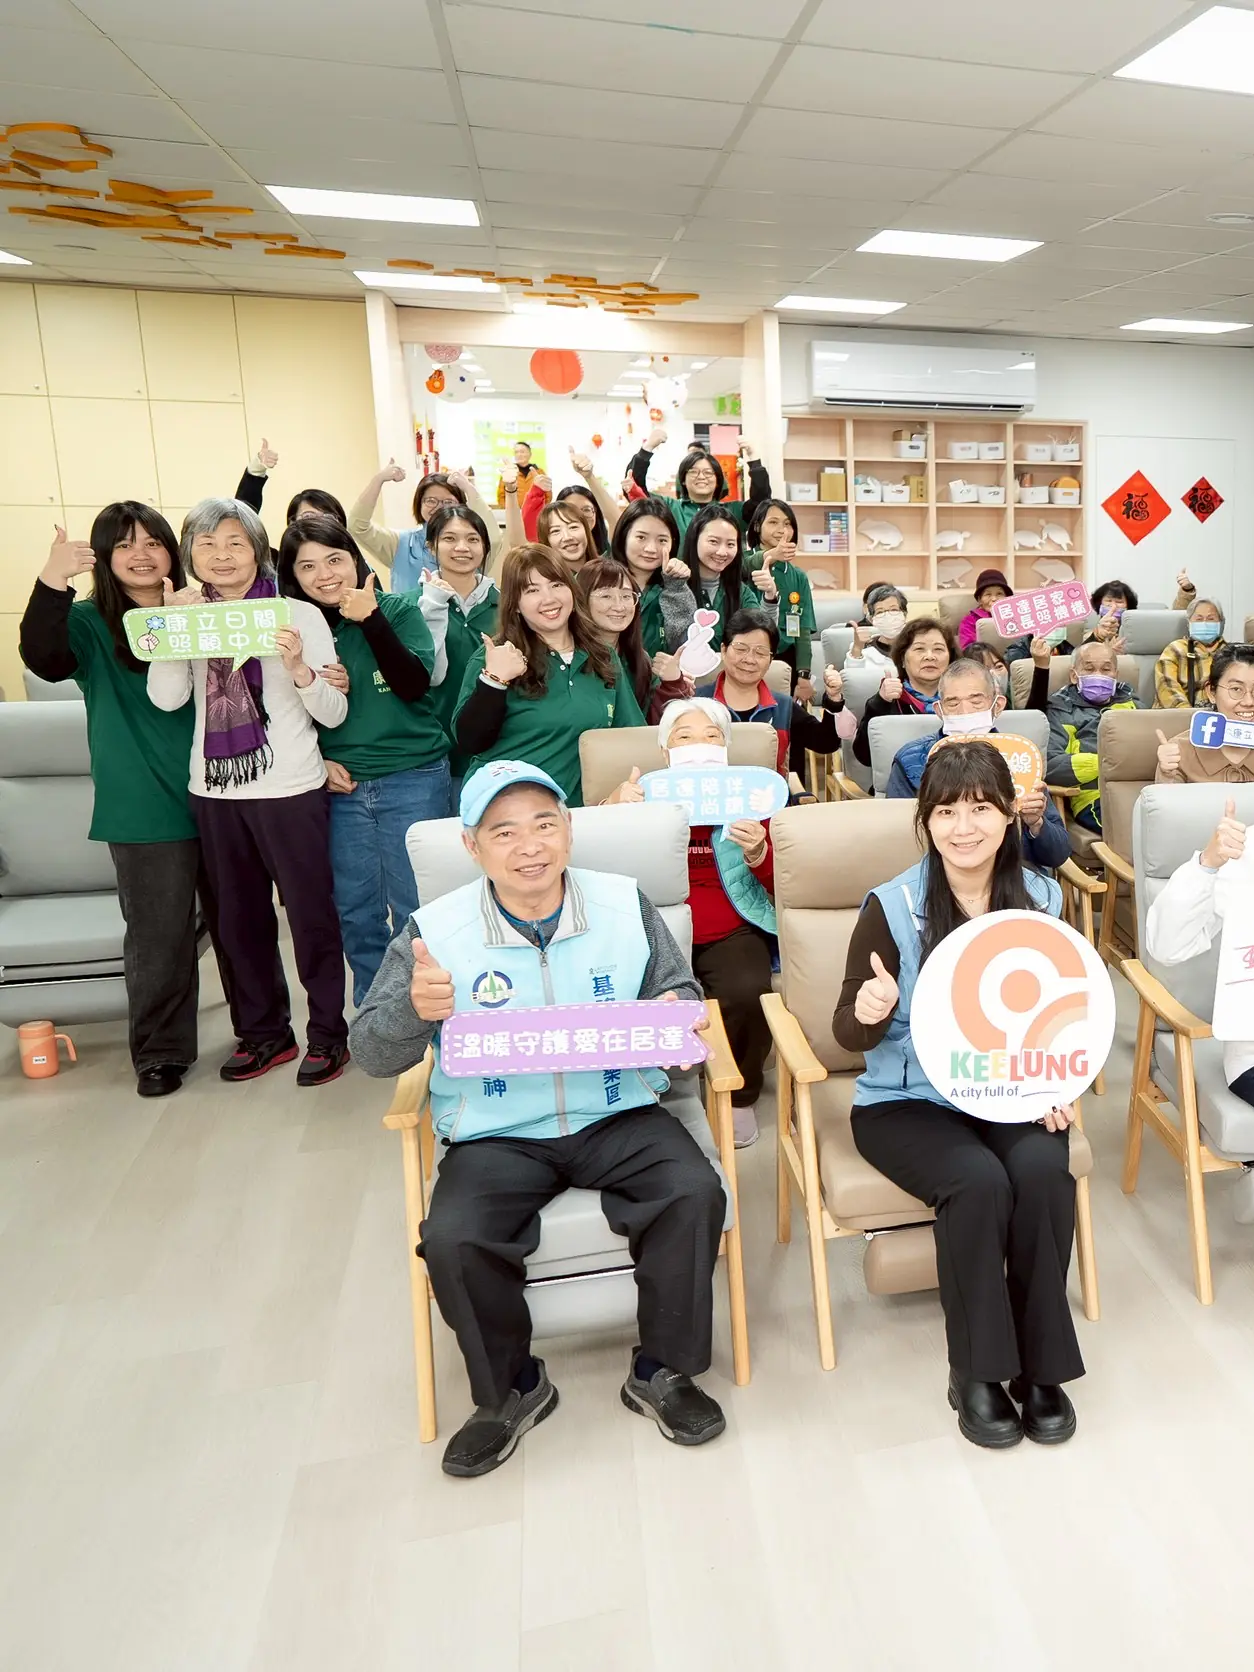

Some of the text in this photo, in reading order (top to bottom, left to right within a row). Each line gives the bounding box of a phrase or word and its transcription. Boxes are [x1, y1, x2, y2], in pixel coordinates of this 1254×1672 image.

[998, 590, 1065, 620] 居達居家
[1020, 600, 1087, 629] 長照機構
[165, 609, 277, 632] 康立日間
[168, 630, 277, 652] 照顧中心
[650, 776, 745, 798] 居達陪伴
[453, 1026, 683, 1058] 溫暖守護愛在居達
[950, 1049, 1089, 1082] KEELUNG
[950, 1085, 1019, 1100] A city full of
